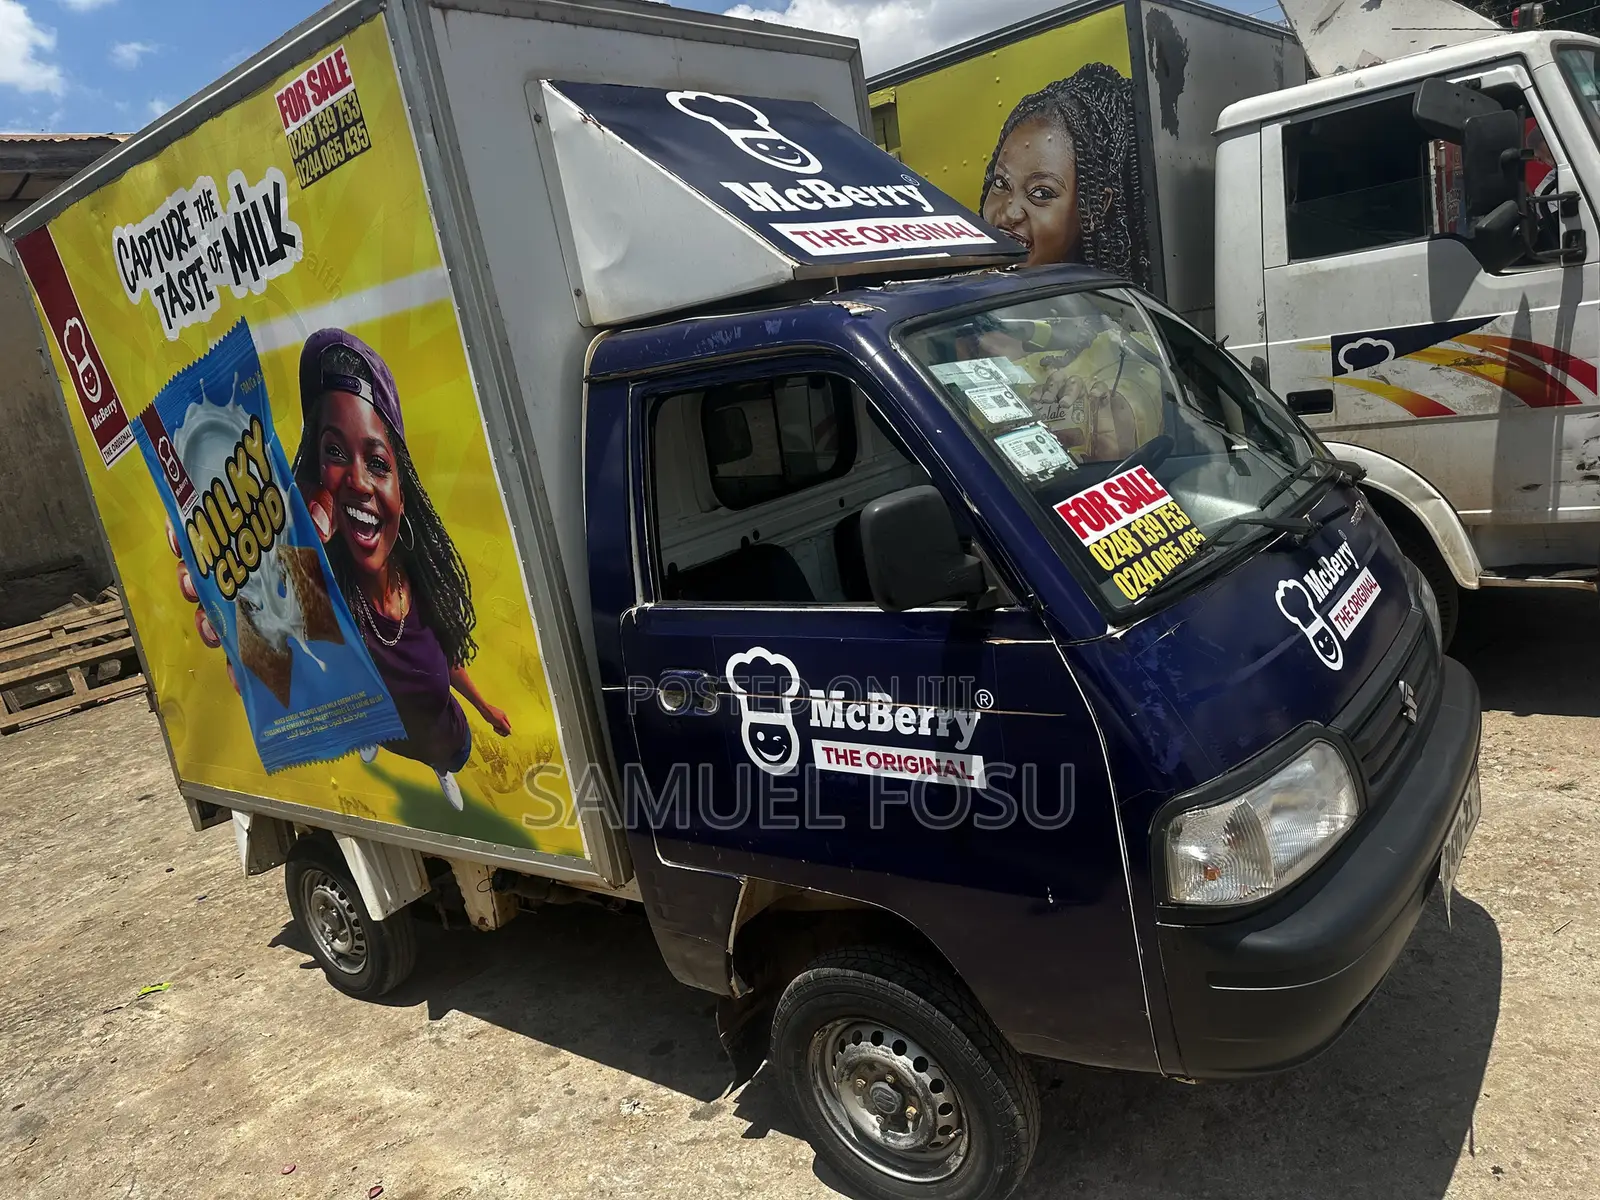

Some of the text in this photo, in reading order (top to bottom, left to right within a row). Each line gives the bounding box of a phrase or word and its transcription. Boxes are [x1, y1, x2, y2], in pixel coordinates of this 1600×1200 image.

[276, 48, 352, 129] FOR SALE
[288, 90, 361, 160] 0248 139 753
[296, 122, 369, 187] 0244 065 435
[719, 178, 935, 213] McBerry
[117, 189, 218, 294] CAPTURE THE
[154, 181, 296, 330] TASTE OF MILK
[789, 221, 985, 249] THE ORIGINAL
[91, 398, 118, 430] McBerry
[103, 429, 132, 460] THE ORIGINAL
[186, 415, 271, 578] MILKY
[1056, 467, 1168, 540] FOR SALE
[215, 483, 285, 599] CLOUD
[1089, 501, 1191, 571] 0248 139 753
[1113, 556, 1163, 600] 0244
[1302, 541, 1360, 604] McBerry
[1333, 574, 1378, 632] THE ORIGINAL
[809, 688, 981, 751] McBerry
[821, 746, 975, 782] THE ORIGINAL
